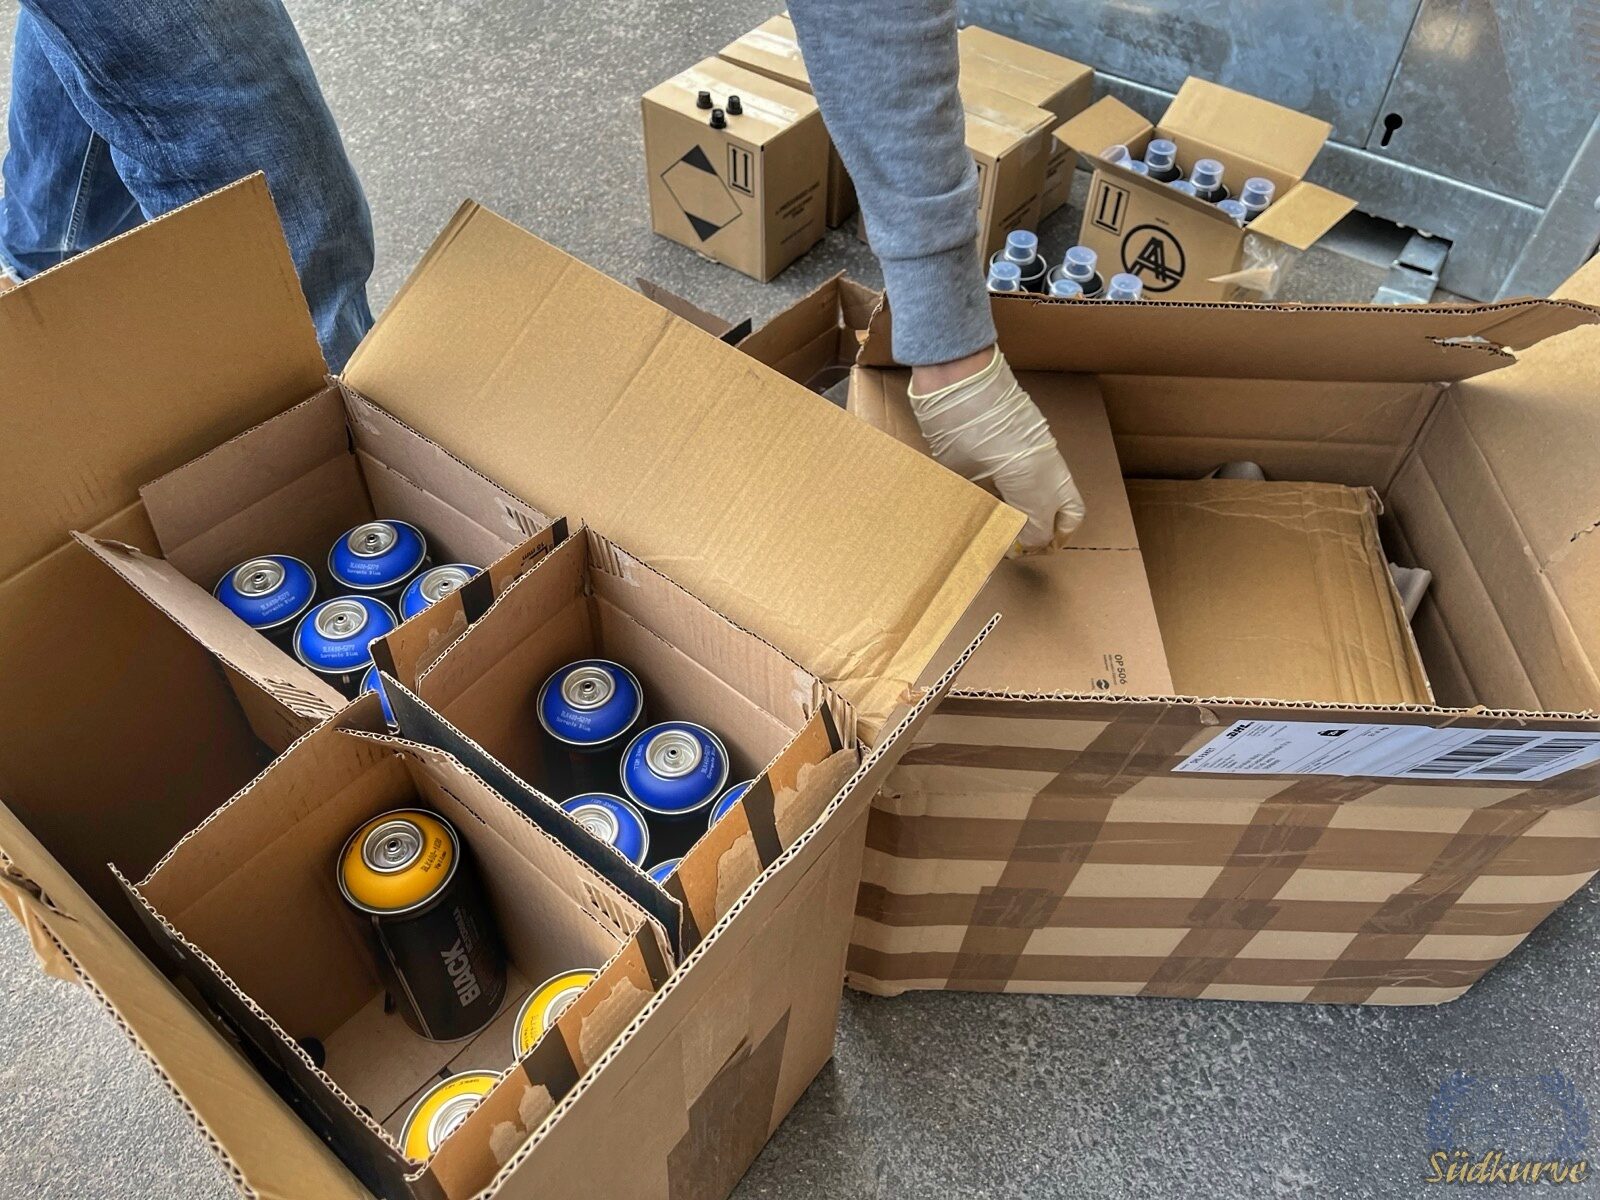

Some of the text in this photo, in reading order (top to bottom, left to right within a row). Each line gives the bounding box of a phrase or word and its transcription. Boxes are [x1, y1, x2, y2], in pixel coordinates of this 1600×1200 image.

[1114, 654, 1128, 685] OP 506
[1226, 721, 1255, 739] DHL
[440, 938, 481, 1007] BLACK
